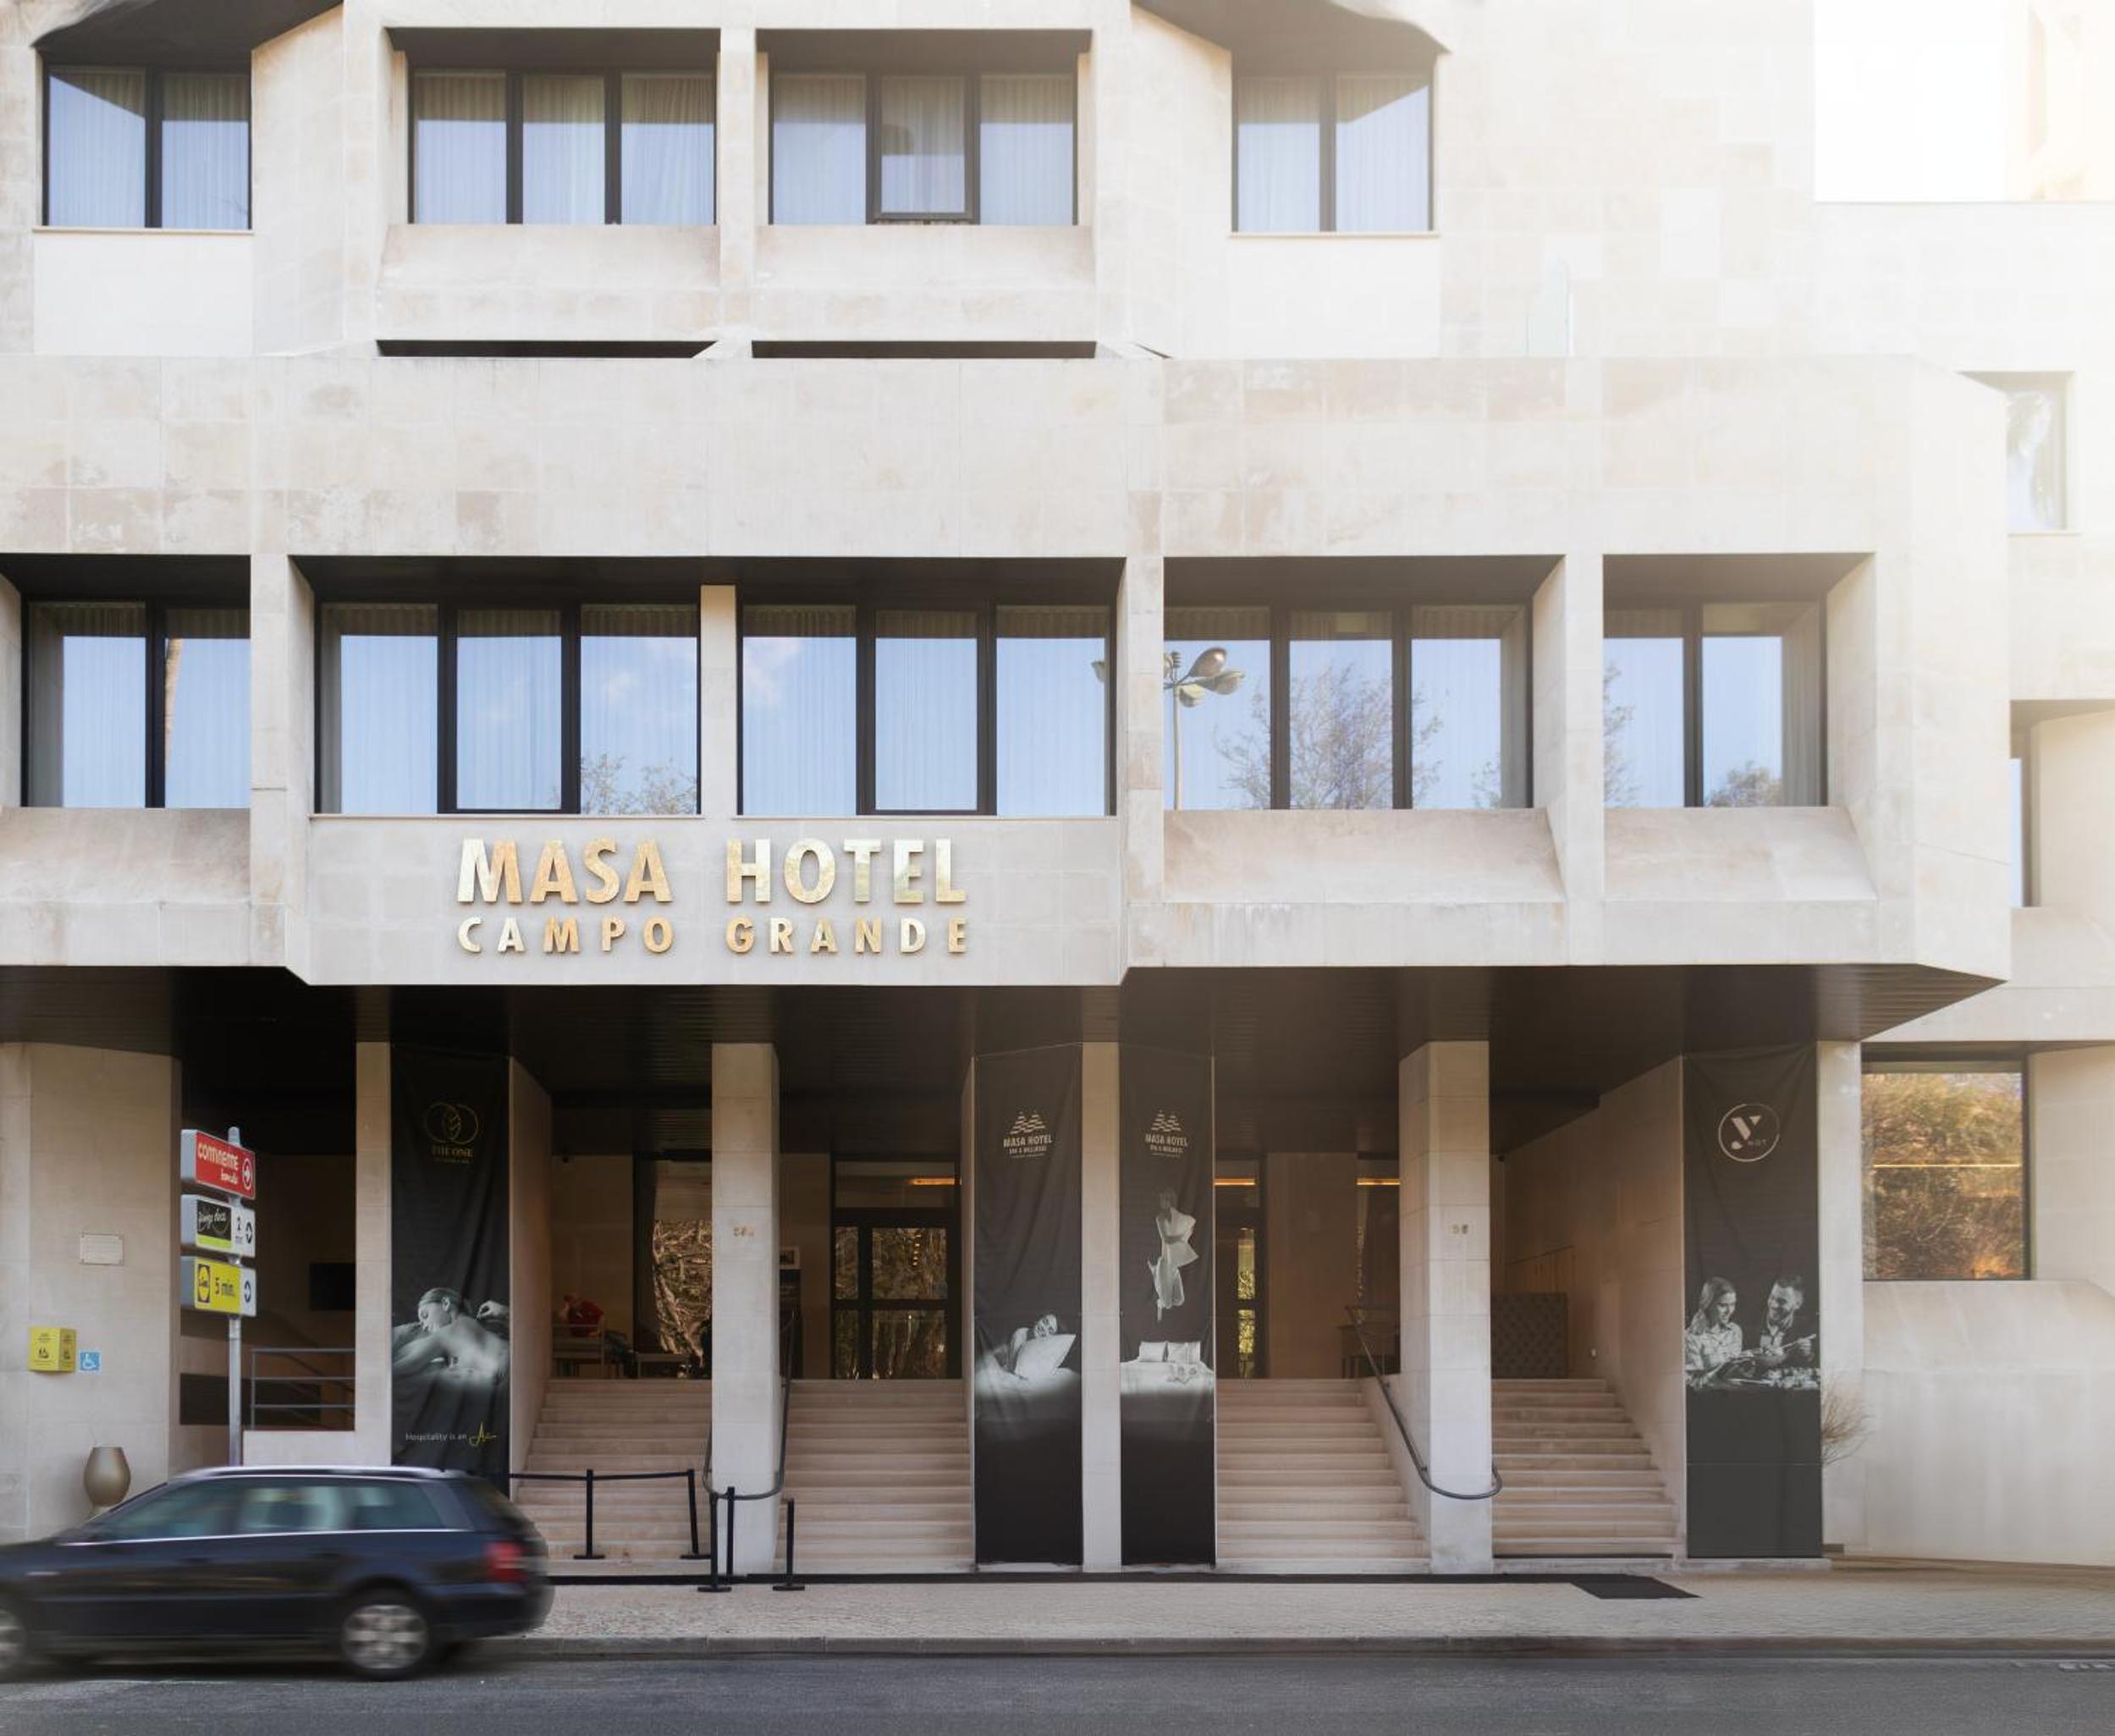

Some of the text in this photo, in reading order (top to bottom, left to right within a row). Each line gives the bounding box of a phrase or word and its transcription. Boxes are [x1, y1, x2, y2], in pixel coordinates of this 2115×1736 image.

[457, 837, 967, 904] MASA HOTEL
[457, 917, 967, 954] CAMPO GRANDE
[1003, 1134, 1053, 1148] MASA HOTEL
[1145, 1133, 1188, 1147] MASA HOTEL
